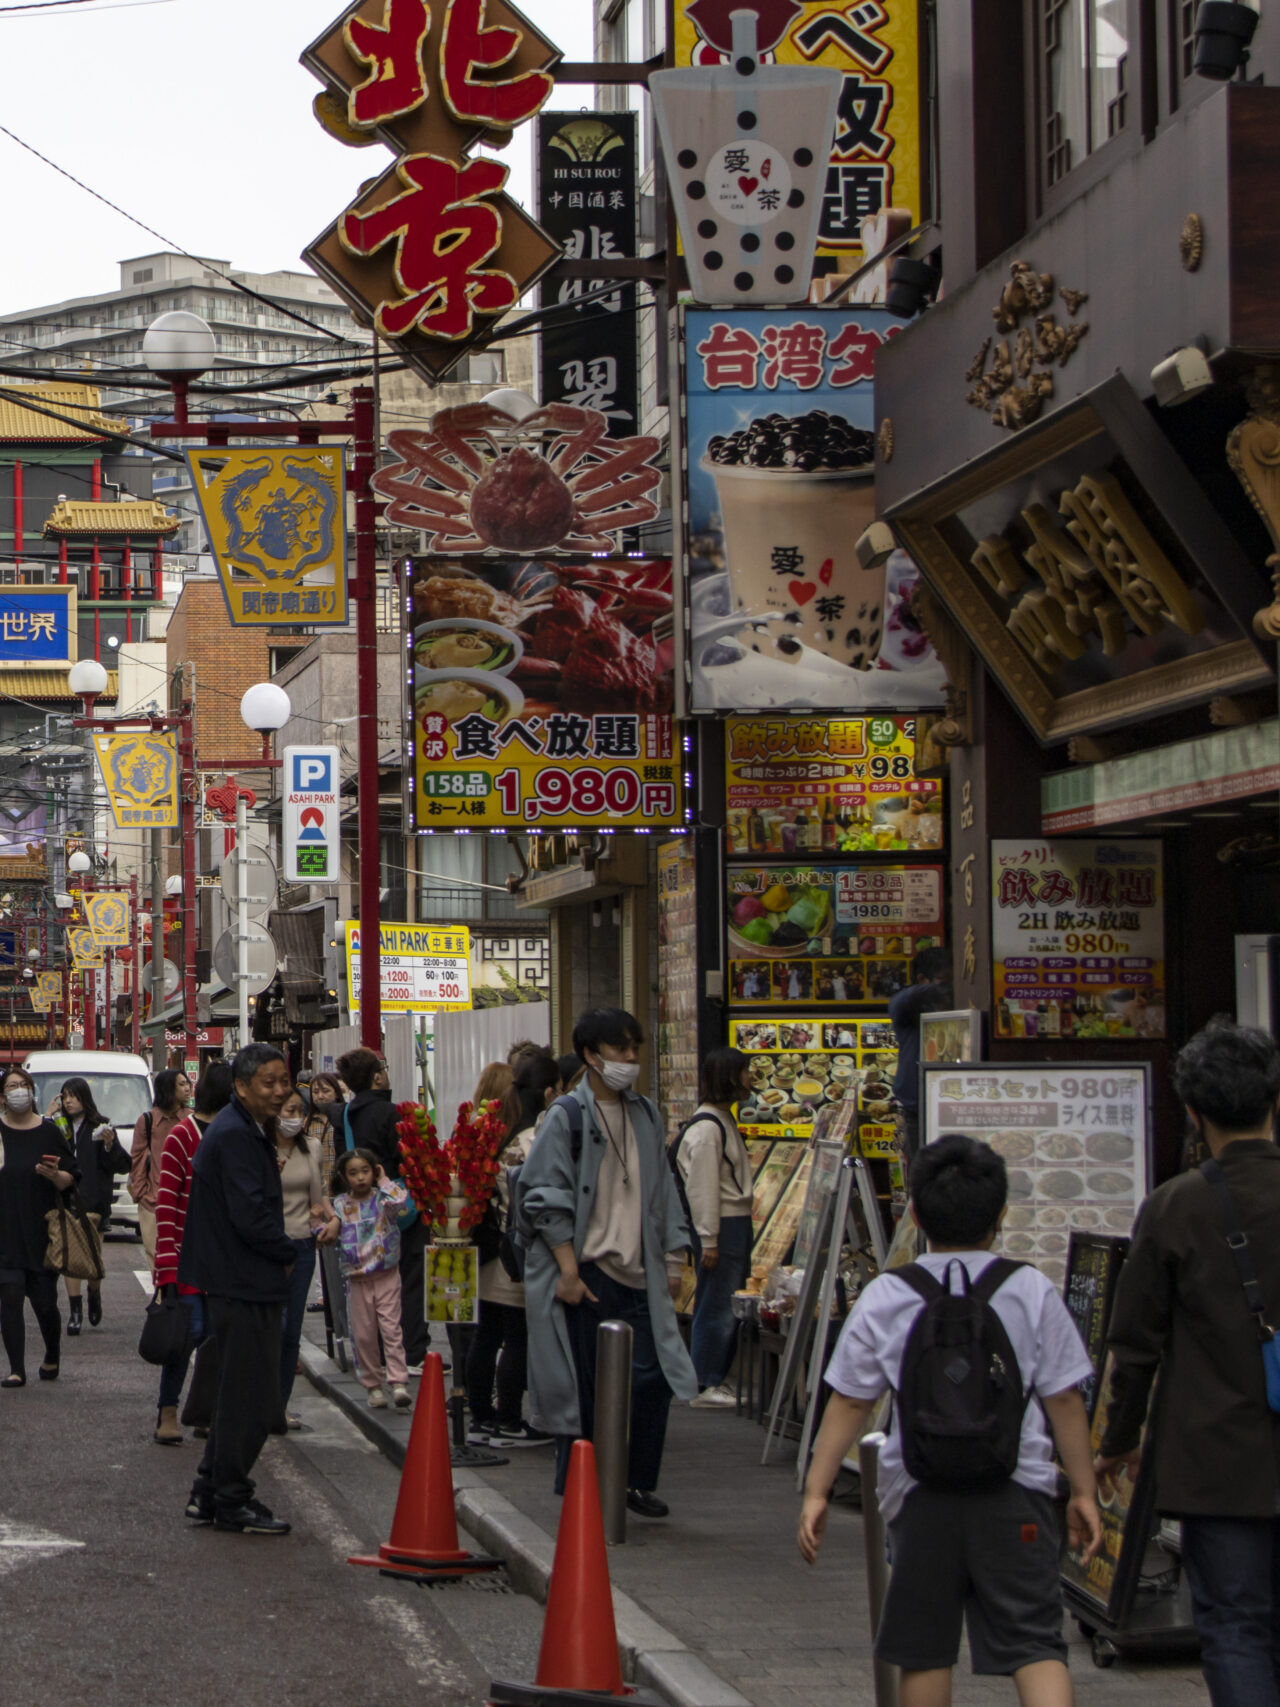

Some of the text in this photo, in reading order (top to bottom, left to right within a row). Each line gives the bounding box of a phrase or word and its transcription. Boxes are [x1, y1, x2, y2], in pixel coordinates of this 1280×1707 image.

[338, 0, 554, 340] 北京
[554, 168, 621, 179] HI SUI ROU
[724, 148, 781, 211] 愛 茶
[696, 322, 905, 391] 台湾タ
[770, 546, 845, 622] 愛 茶
[242, 591, 337, 615] 関帝廟通り
[452, 713, 641, 760] 食べ放題
[871, 720, 894, 735] 50
[730, 720, 866, 762] 飲み放題
[299, 759, 326, 788] P
[643, 766, 673, 780] 税抜
[740, 763, 846, 779] 時間たっぷり2時間
[853, 756, 915, 779] ¥98
[425, 773, 488, 796] 158品
[288, 794, 335, 804] ASAHI PARK
[428, 801, 486, 816] お一人様
[839, 874, 903, 889] 158品
[998, 868, 1156, 908] 飲み放題
[1018, 911, 1140, 931] 2H 飲み放題
[400, 932, 431, 952] PARK
[433, 936, 465, 952] 中華街
[1065, 933, 1130, 953] 980円
[1061, 1078, 1135, 1099] 980円
[1062, 1104, 1135, 1126] ライス無料
